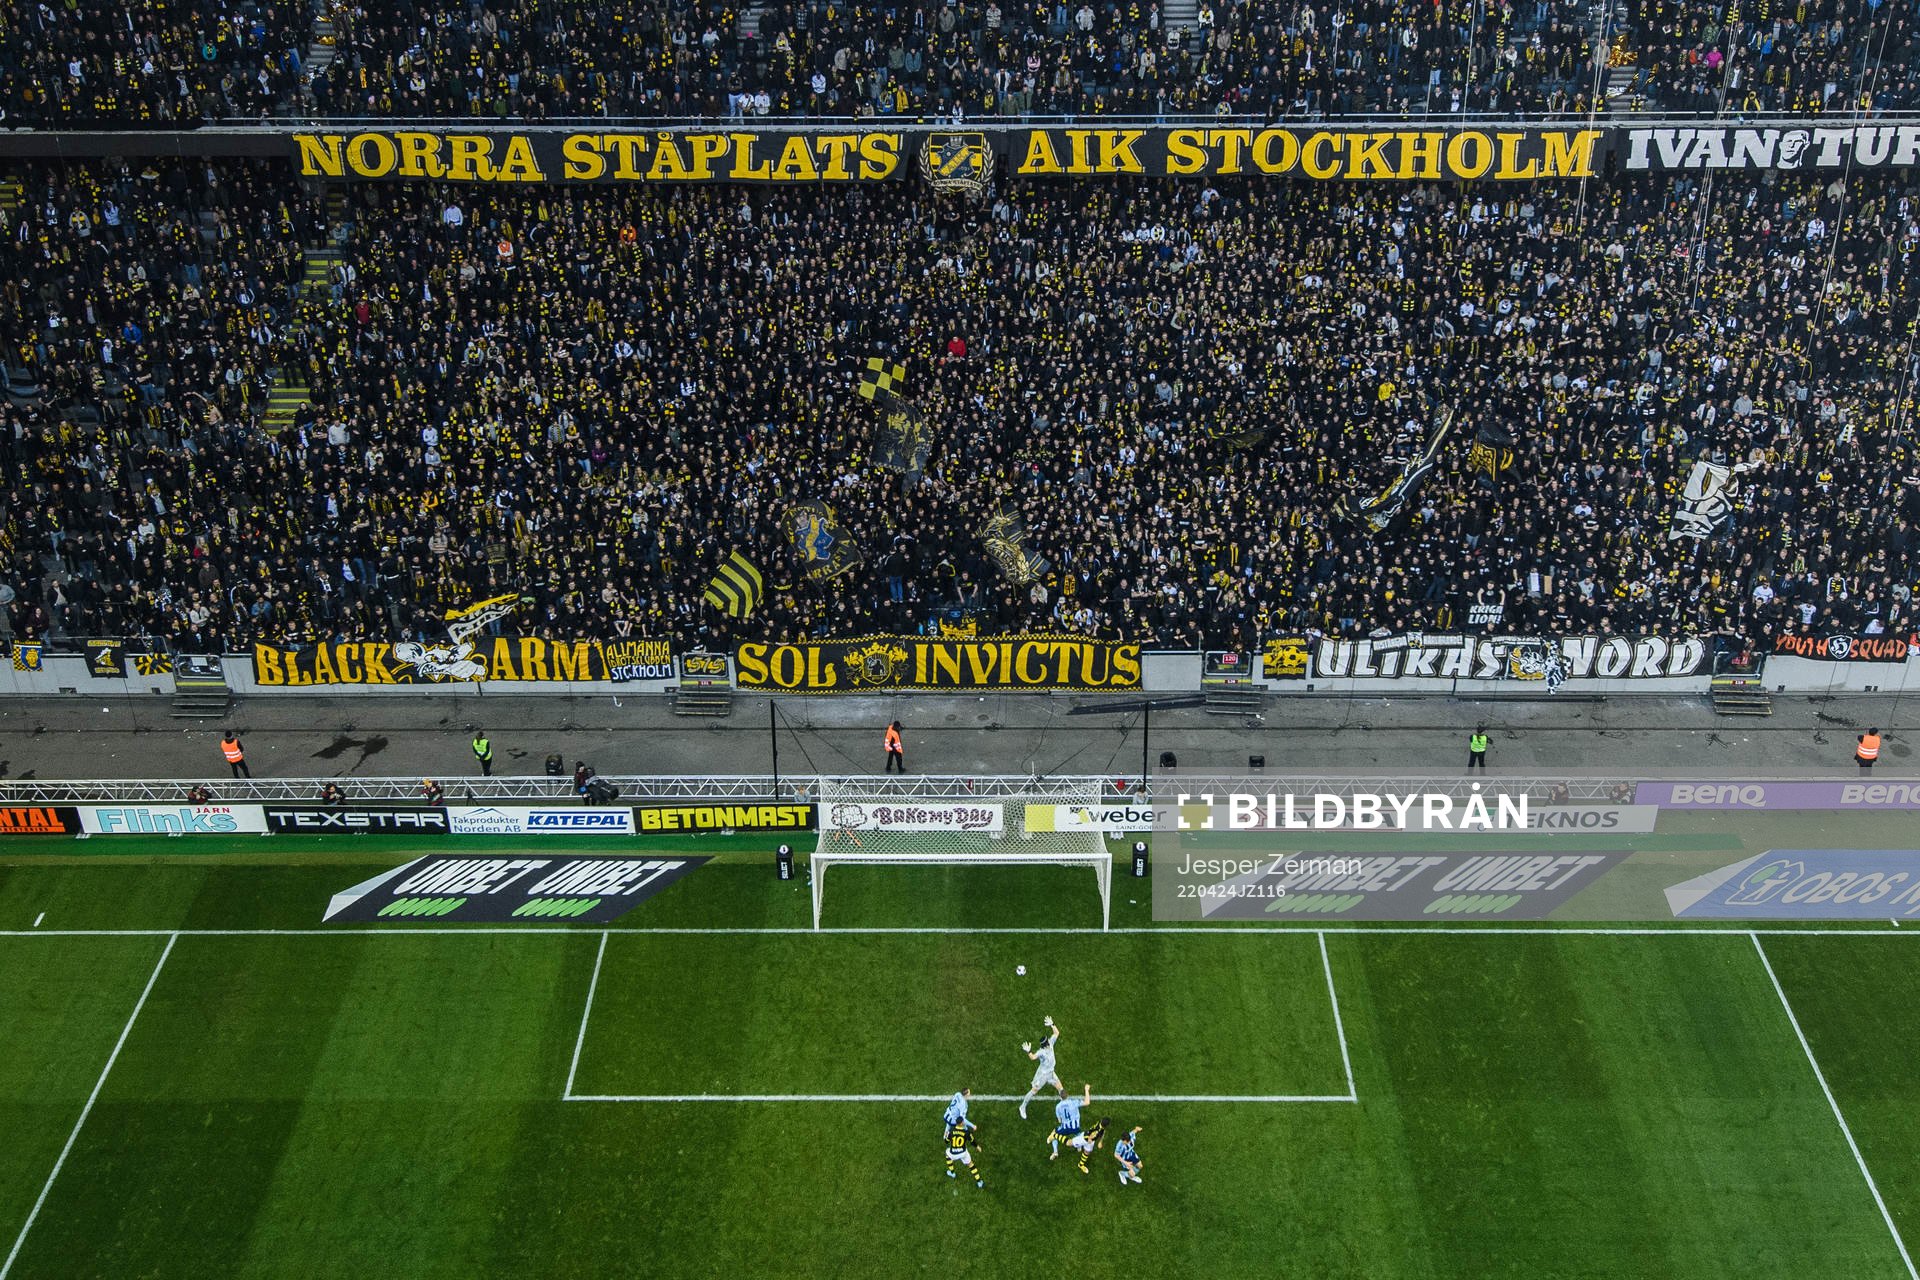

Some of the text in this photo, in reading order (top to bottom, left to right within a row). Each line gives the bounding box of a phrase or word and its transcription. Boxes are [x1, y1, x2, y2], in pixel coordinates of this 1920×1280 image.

[292, 132, 547, 181] NORRA
[562, 131, 903, 180] STÅPLATS
[1017, 130, 1146, 174] AIK
[1167, 129, 1602, 180] STOCKHOLM
[1626, 129, 1780, 169] IVAN
[1469, 605, 1504, 614] KRIGA
[607, 640, 670, 659] ALLMÄNNA
[1562, 634, 1706, 679] NORD
[1775, 634, 1829, 657] YOUTH
[1850, 638, 1907, 660] SQUAD
[255, 641, 397, 686] BLACK
[737, 641, 1141, 687] SOL INVICTUS
[1670, 784, 1767, 807] BenQ
[96, 808, 238, 832] Flinks
[269, 812, 445, 828] TEXSTAR
[452, 816, 520, 825] Takprodukter
[527, 815, 628, 826] KATEPAL
[640, 806, 811, 830] BETONMAST
[1088, 806, 1167, 823] weber
[454, 825, 521, 833] Norden AB
[393, 859, 687, 896] UNIBET UNIBET
[1433, 856, 1606, 891] UNIBET
[1781, 872, 1910, 904] OBOS
[1064, 1108, 1071, 1121] 4
[952, 1136, 965, 1148] 10
